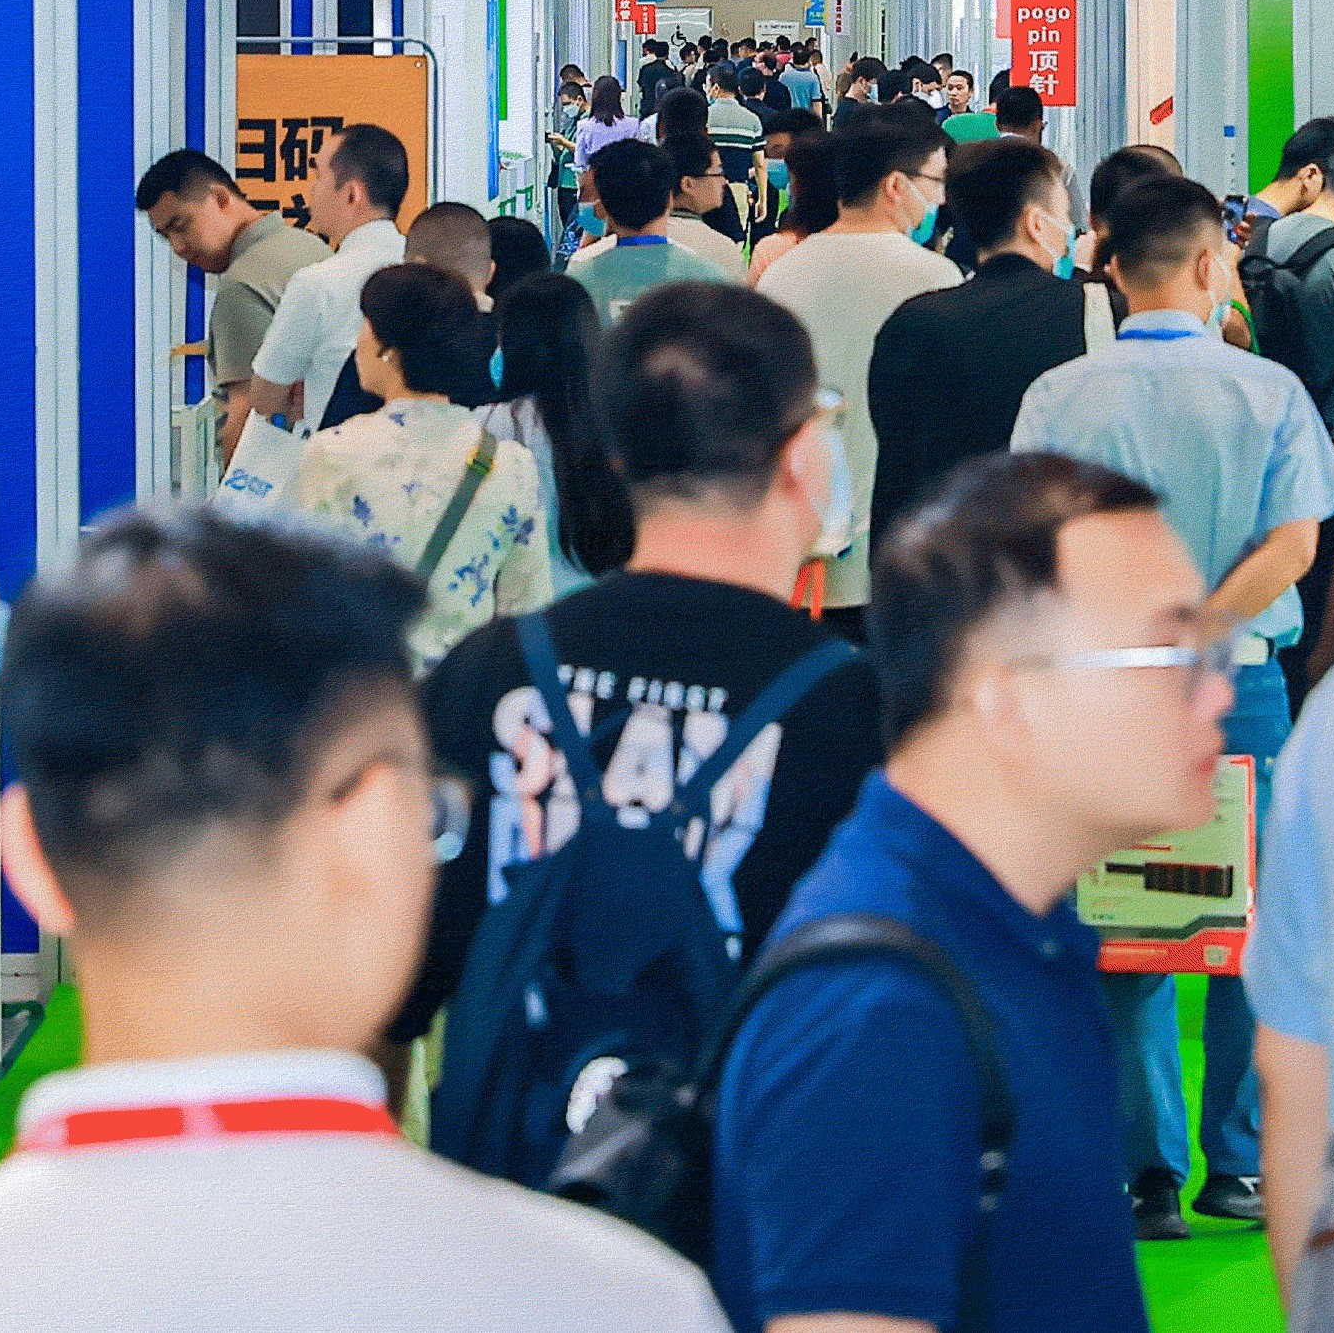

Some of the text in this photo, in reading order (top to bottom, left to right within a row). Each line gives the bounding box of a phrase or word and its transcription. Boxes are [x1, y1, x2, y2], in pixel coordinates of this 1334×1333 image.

[1017, 7, 1070, 24] pogo
[1028, 26, 1060, 45] pin
[1028, 50, 1059, 95] 顶针
